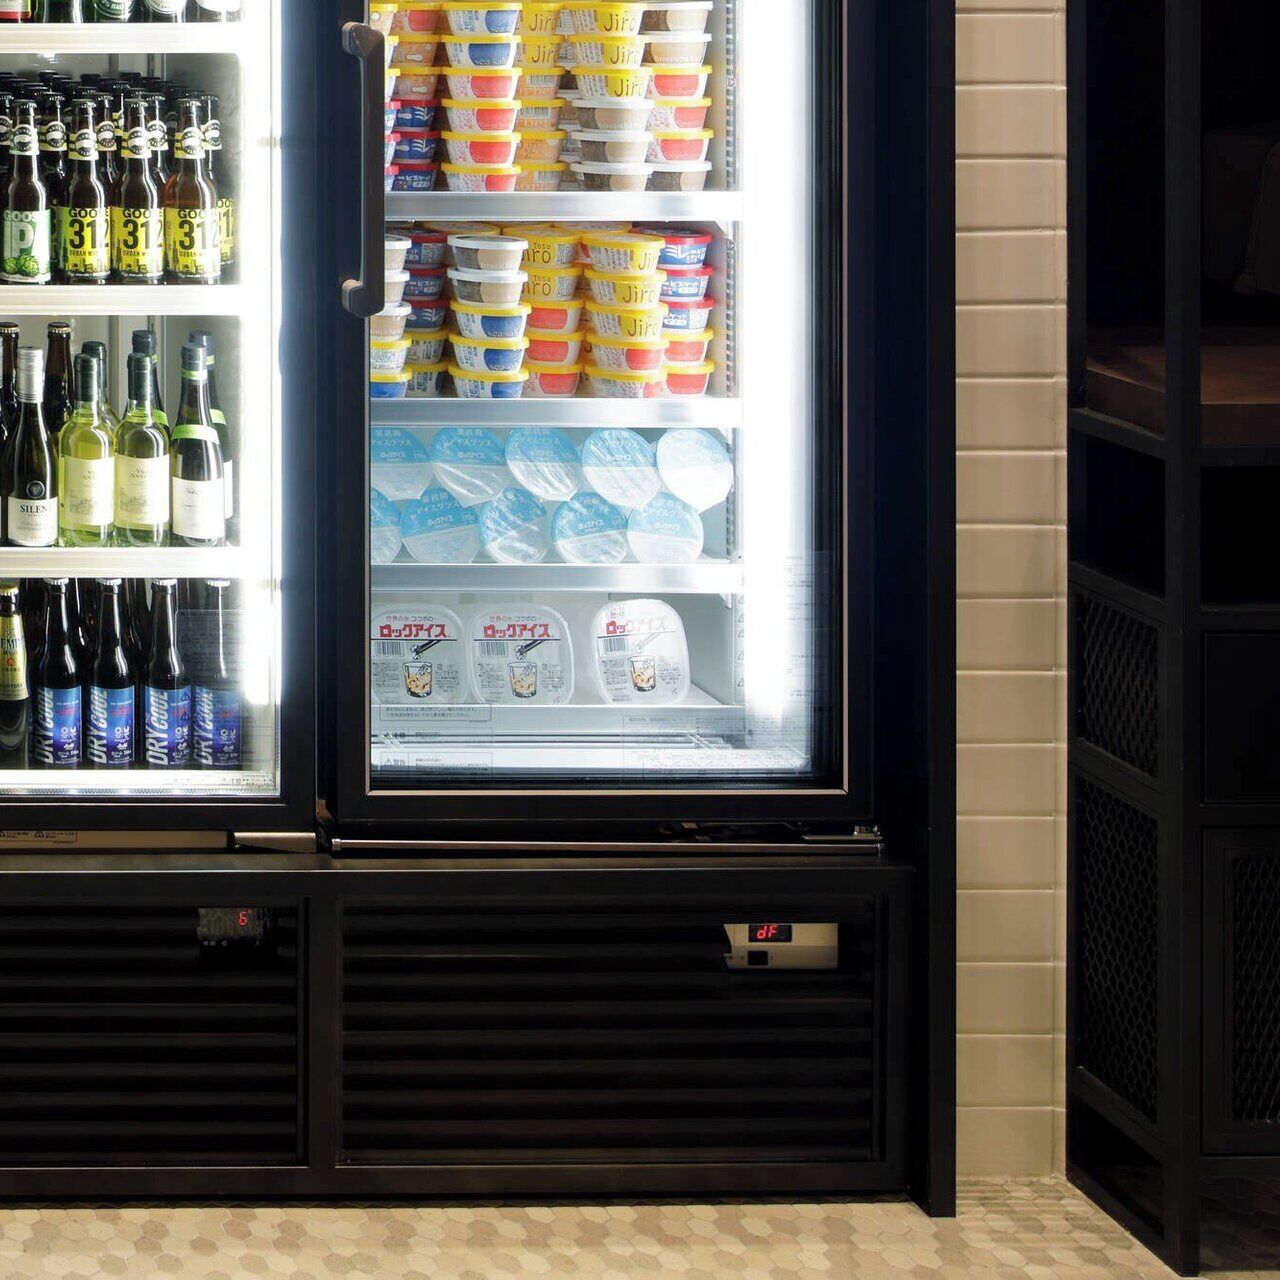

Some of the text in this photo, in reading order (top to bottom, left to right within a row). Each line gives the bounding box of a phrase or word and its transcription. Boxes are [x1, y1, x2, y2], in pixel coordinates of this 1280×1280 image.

[379, 624, 448, 638] ロックアイス
[483, 623, 552, 638] ロックアイス
